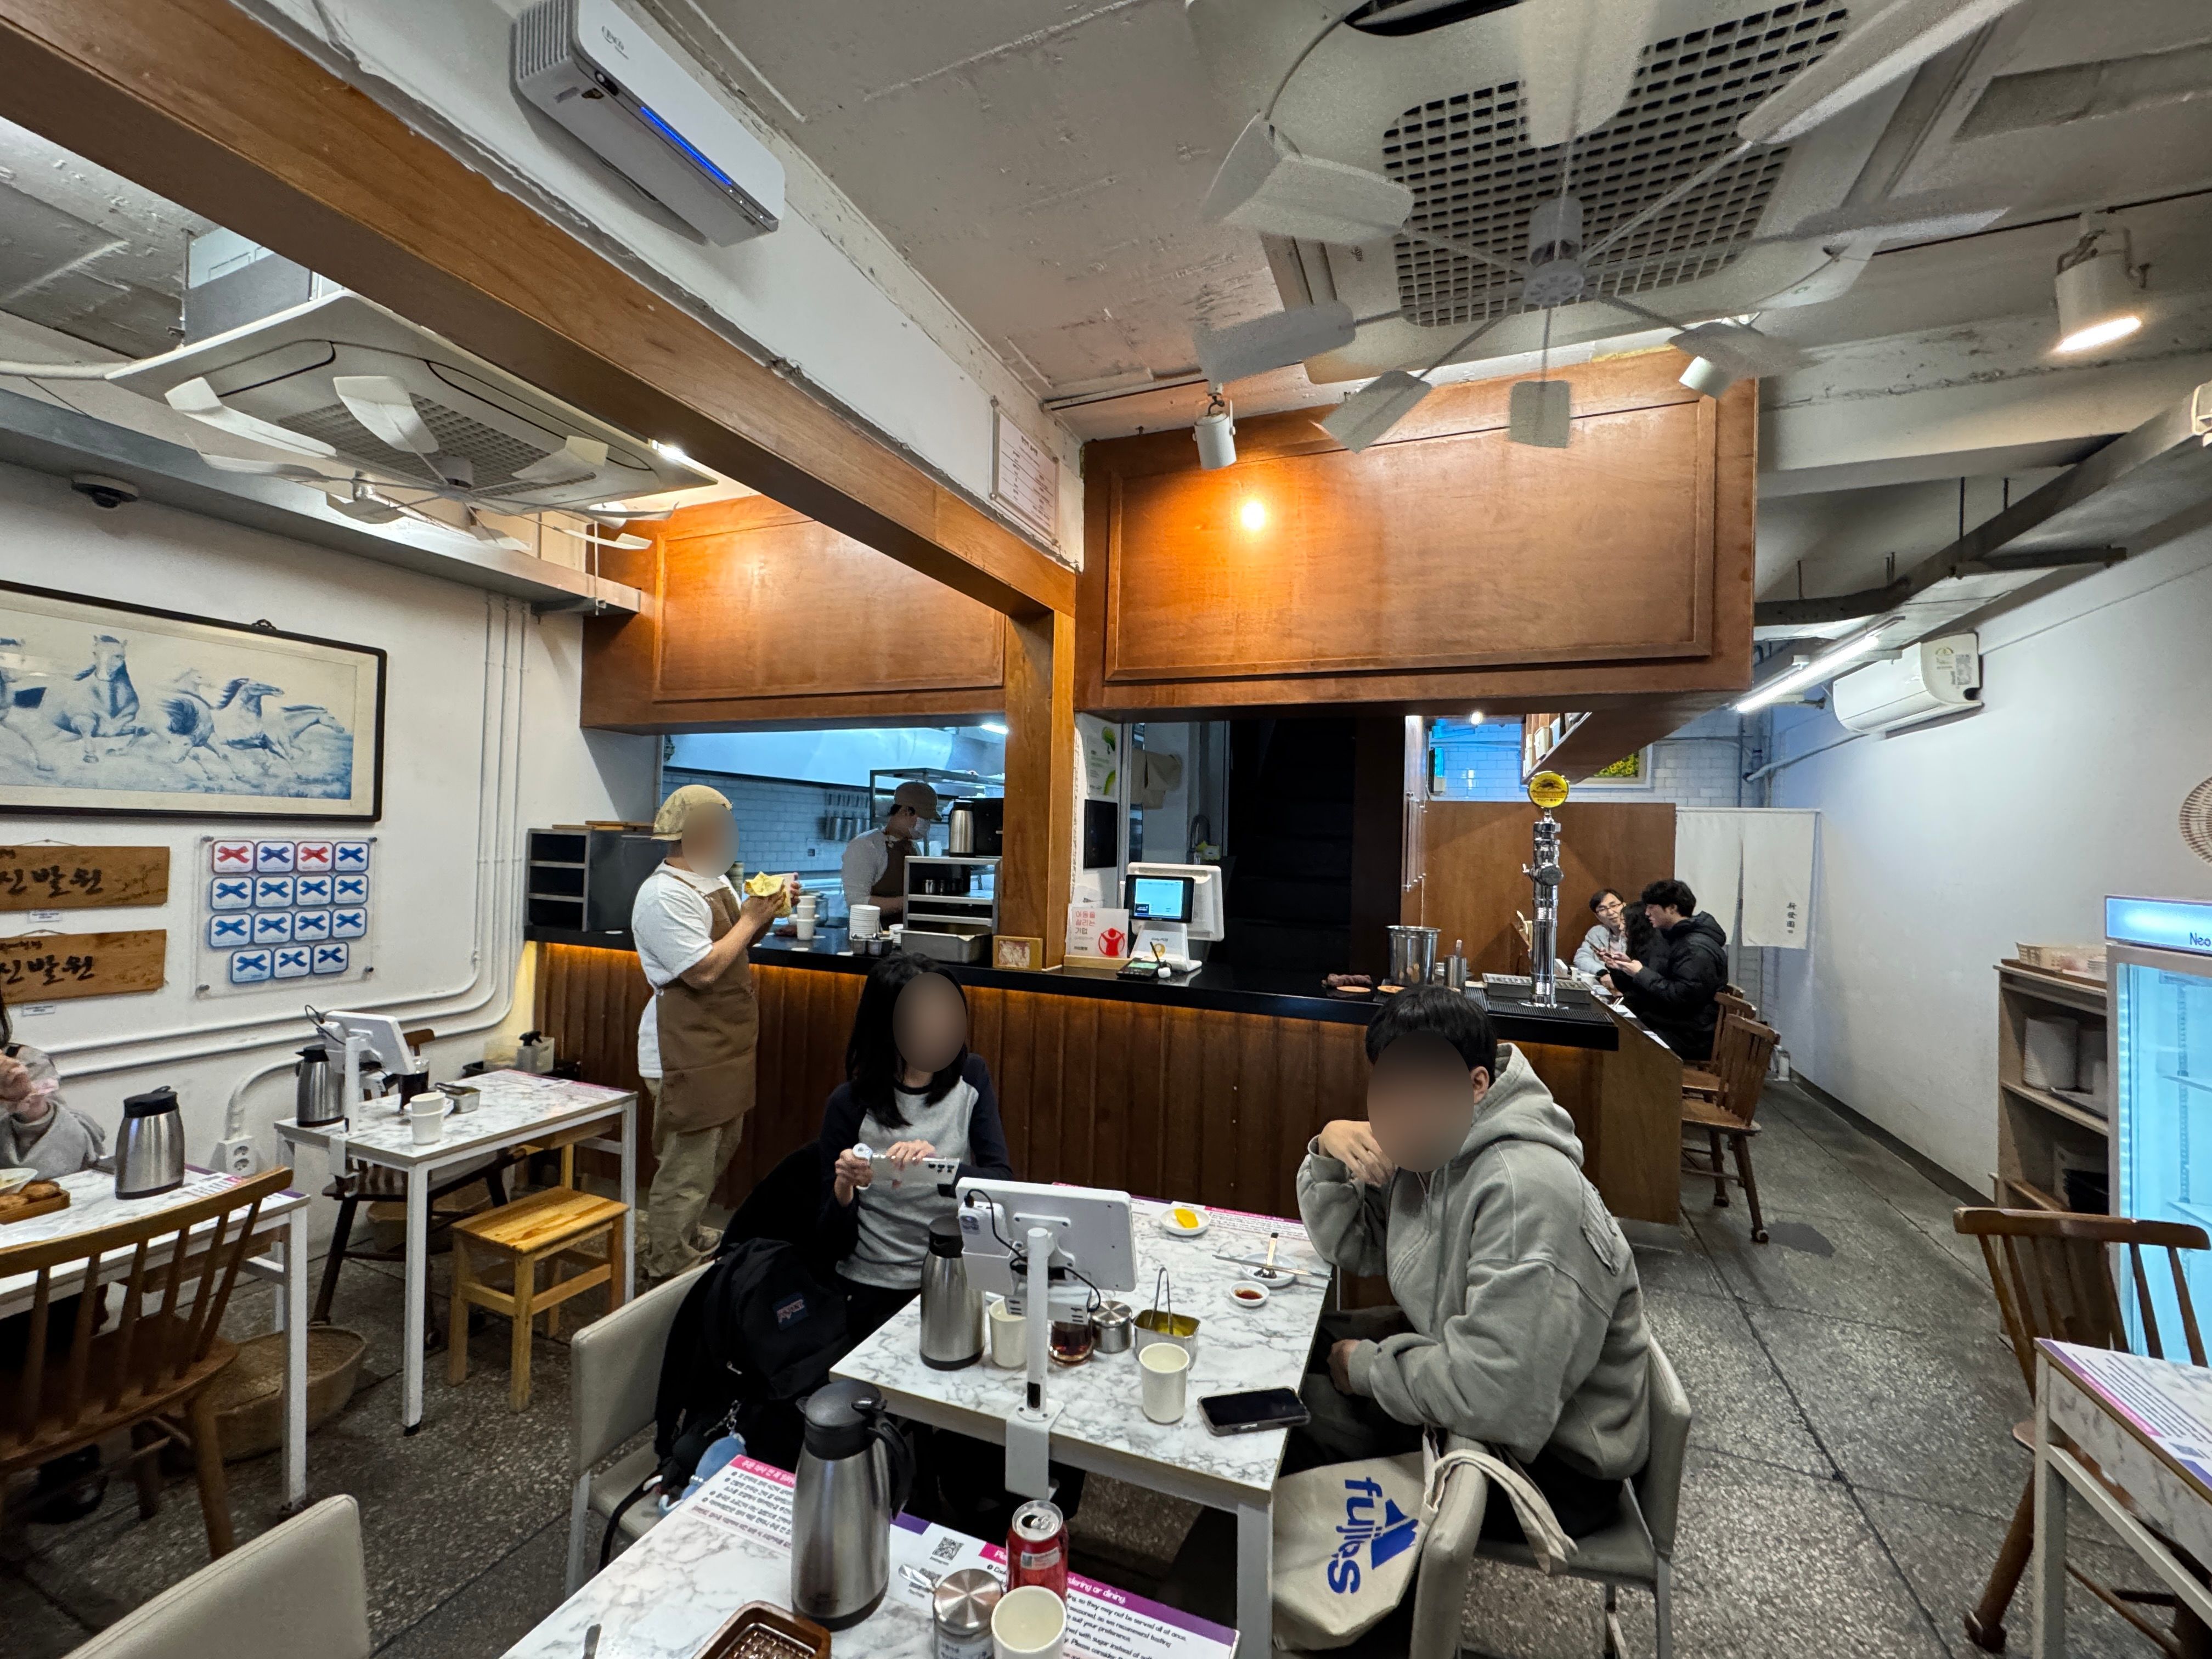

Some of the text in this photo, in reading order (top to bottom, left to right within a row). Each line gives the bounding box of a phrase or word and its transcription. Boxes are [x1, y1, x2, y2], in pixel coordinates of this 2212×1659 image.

[2190, 932, 2211, 947] Neo
[1086, 1600, 1099, 1610] they
[1100, 1606, 1114, 1616] may
[1114, 1611, 1125, 1619] not
[1133, 1618, 1155, 1630] served
[1083, 1621, 1098, 1629] your
[1115, 1622, 1150, 1639] recommend
[1070, 1638, 1091, 1651] Please
[1079, 1631, 1092, 1640] with
[1092, 1637, 1110, 1646] sugar
[1110, 1641, 1133, 1656] instead
